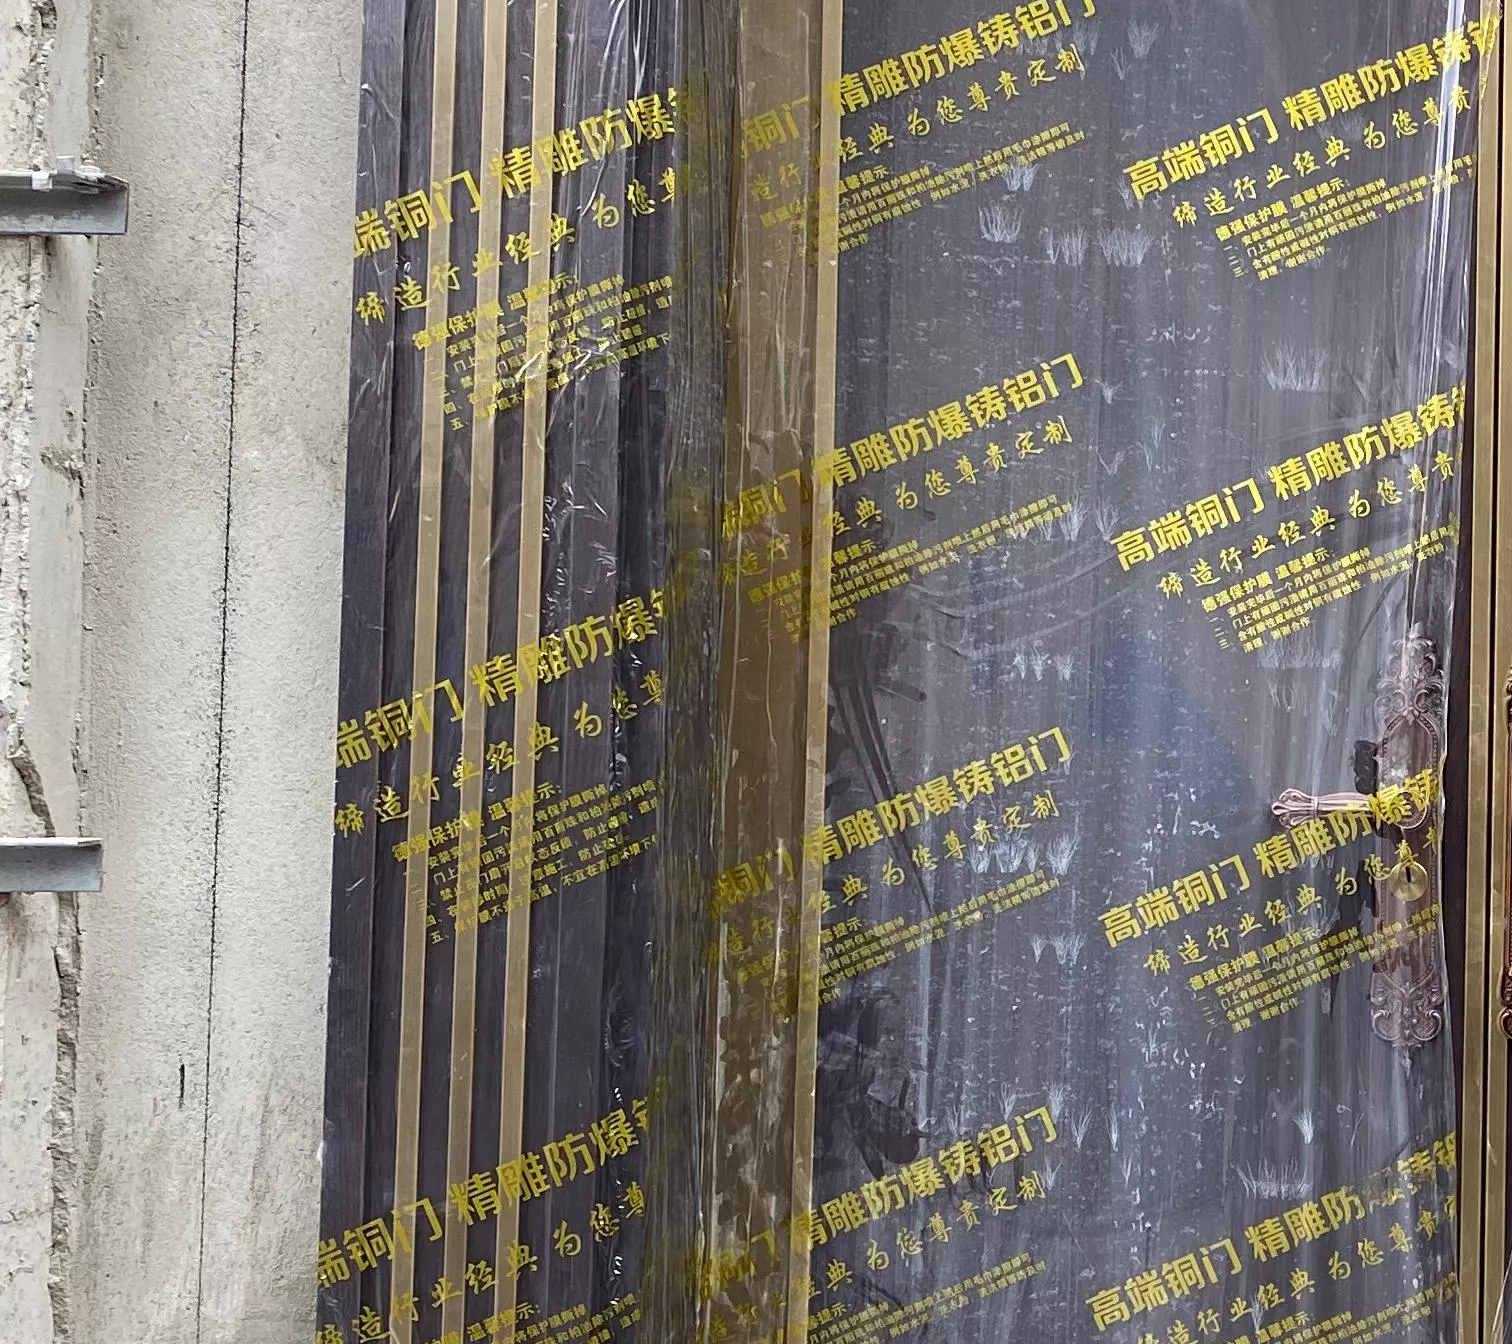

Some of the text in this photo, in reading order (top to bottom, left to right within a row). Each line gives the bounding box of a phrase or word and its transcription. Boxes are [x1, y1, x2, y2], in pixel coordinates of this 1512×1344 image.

[1123, 108, 1280, 200] 高端铜门
[1172, 137, 1351, 228] 缔造行业经典
[1110, 477, 1266, 571] 高端铜门
[1158, 506, 1336, 600] 缔造行业经典
[1096, 853, 1253, 949] 高端铜门
[1145, 883, 1324, 978] 缔造行业经典
[1084, 1236, 1244, 1333] 高端铜门
